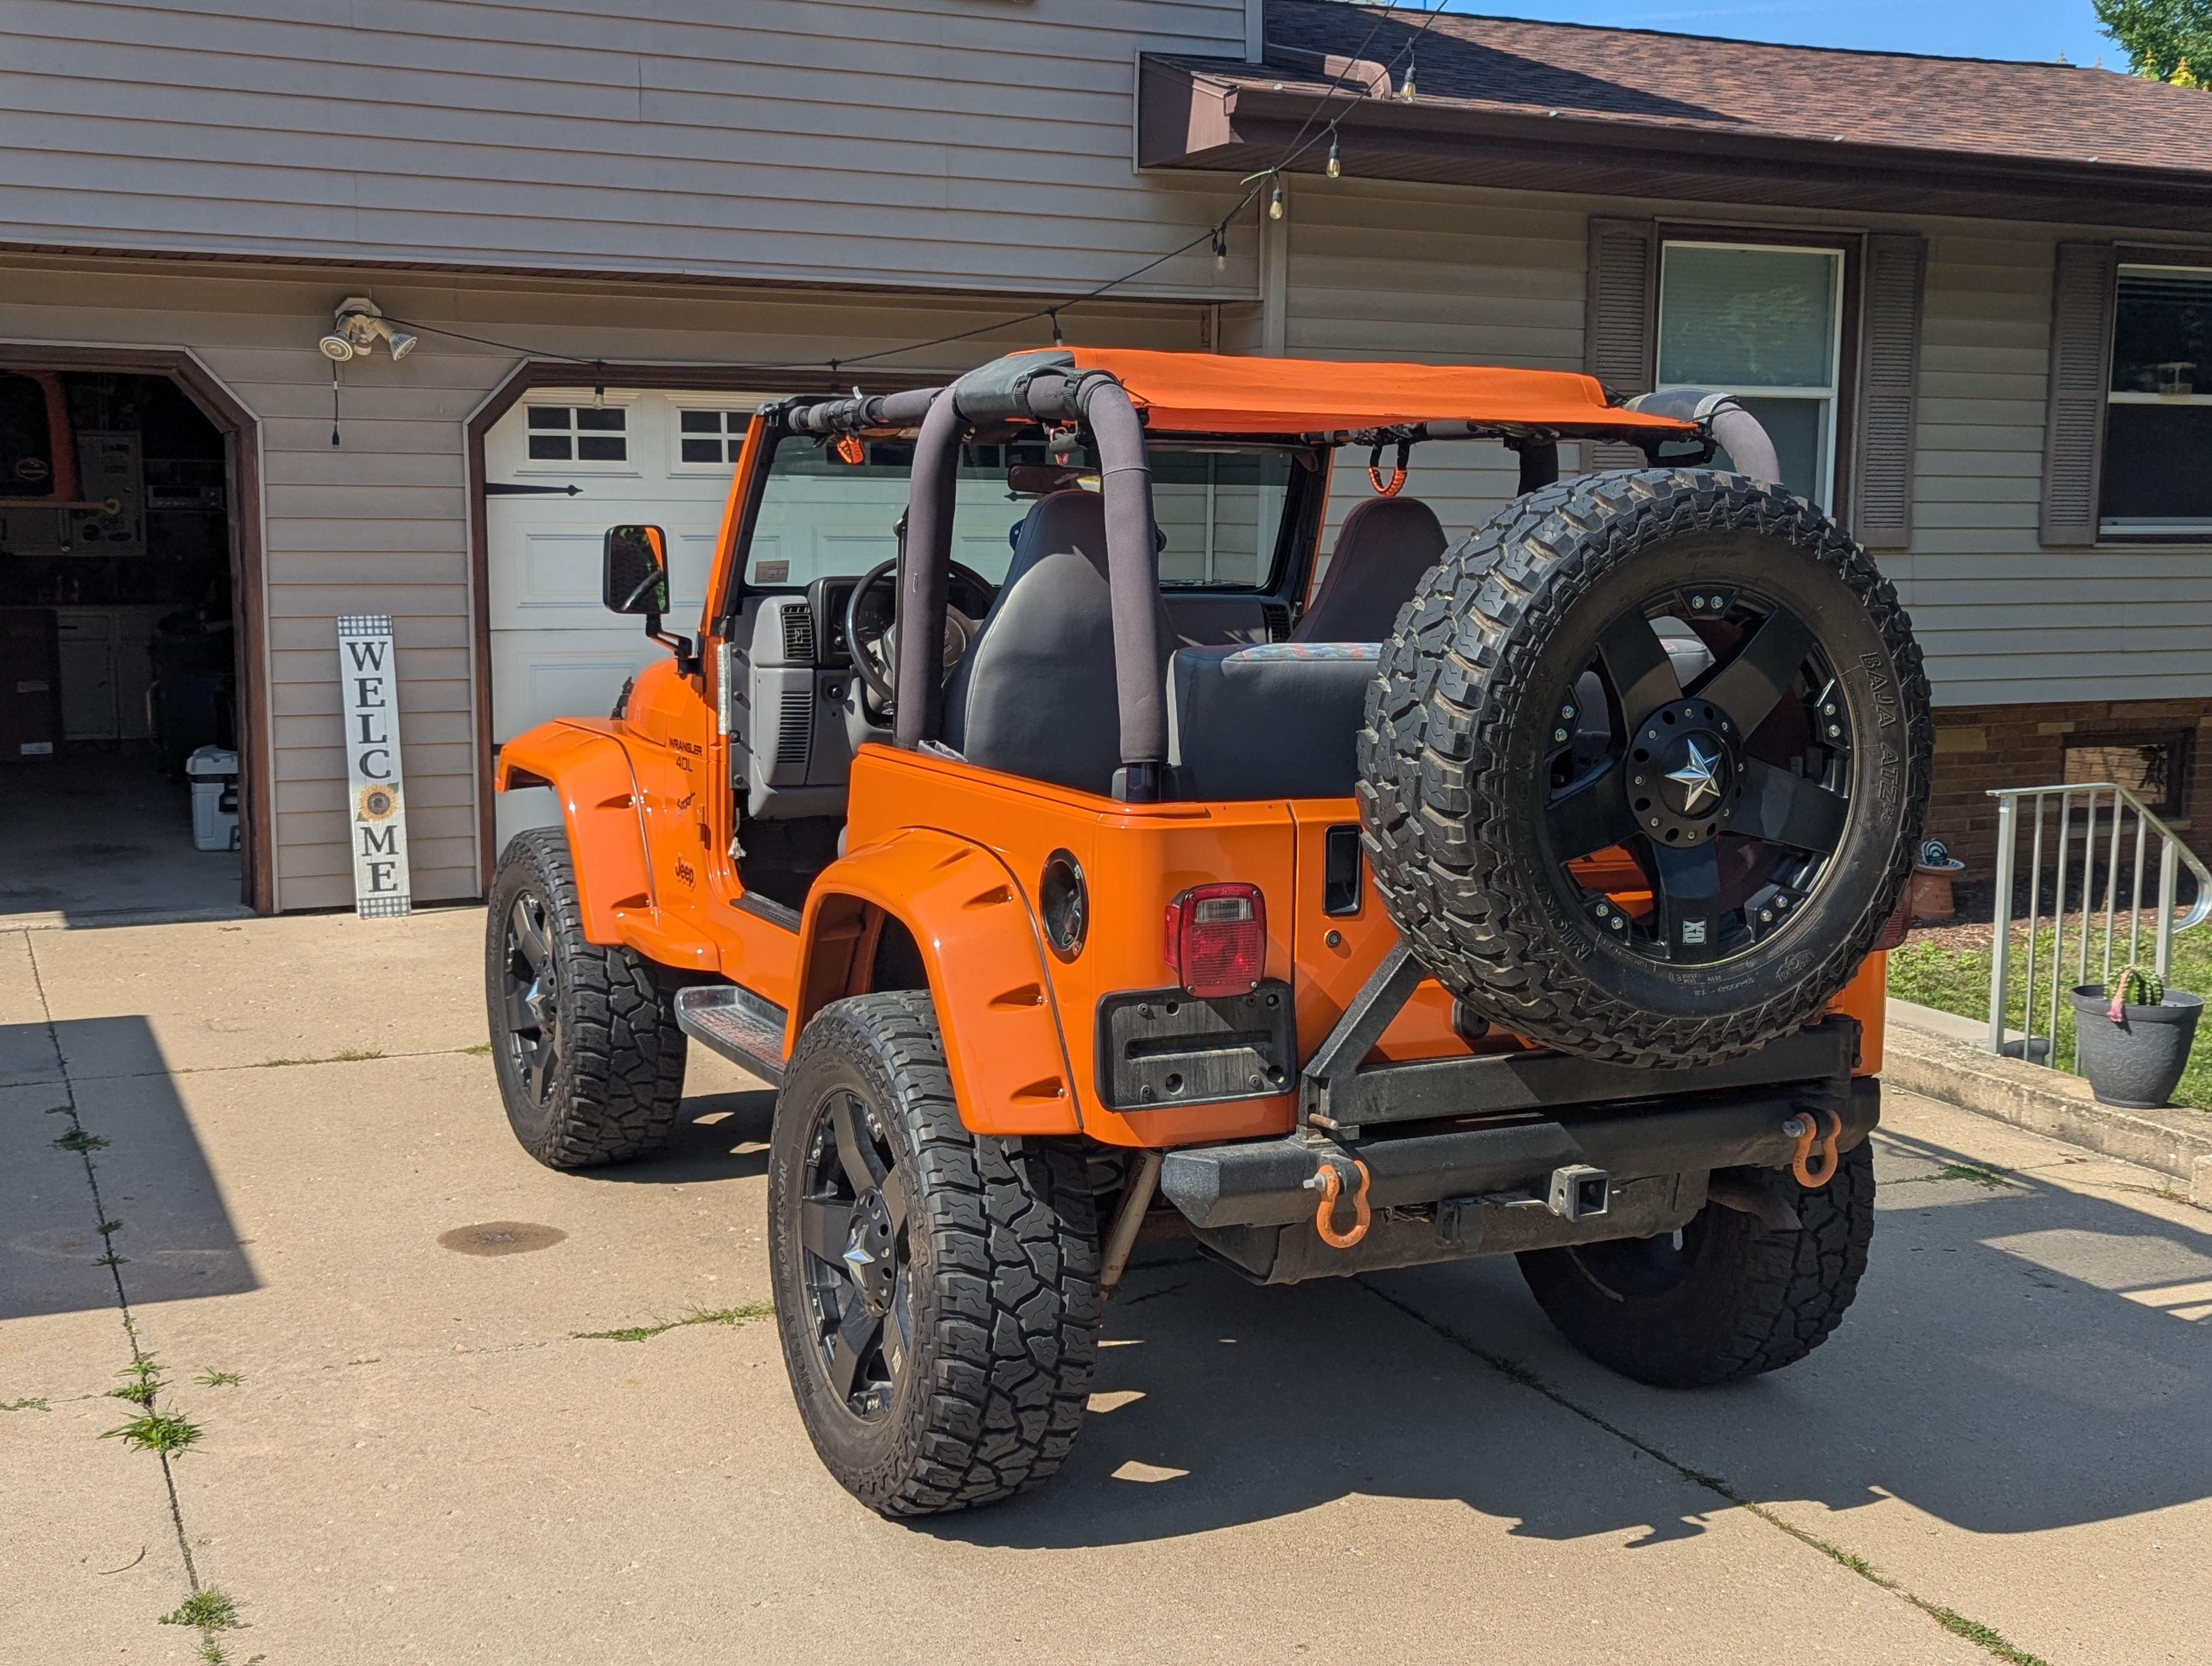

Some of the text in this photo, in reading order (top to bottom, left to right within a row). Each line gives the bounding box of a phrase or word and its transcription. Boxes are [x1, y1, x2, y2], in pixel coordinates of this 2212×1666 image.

[1859, 651, 1896, 729] BAJA
[345, 641, 400, 893] WELCME
[668, 736, 703, 757] WRANGLER
[675, 856, 695, 888] Jeep
[776, 1158, 817, 1396] MICKEY THOMPSON
